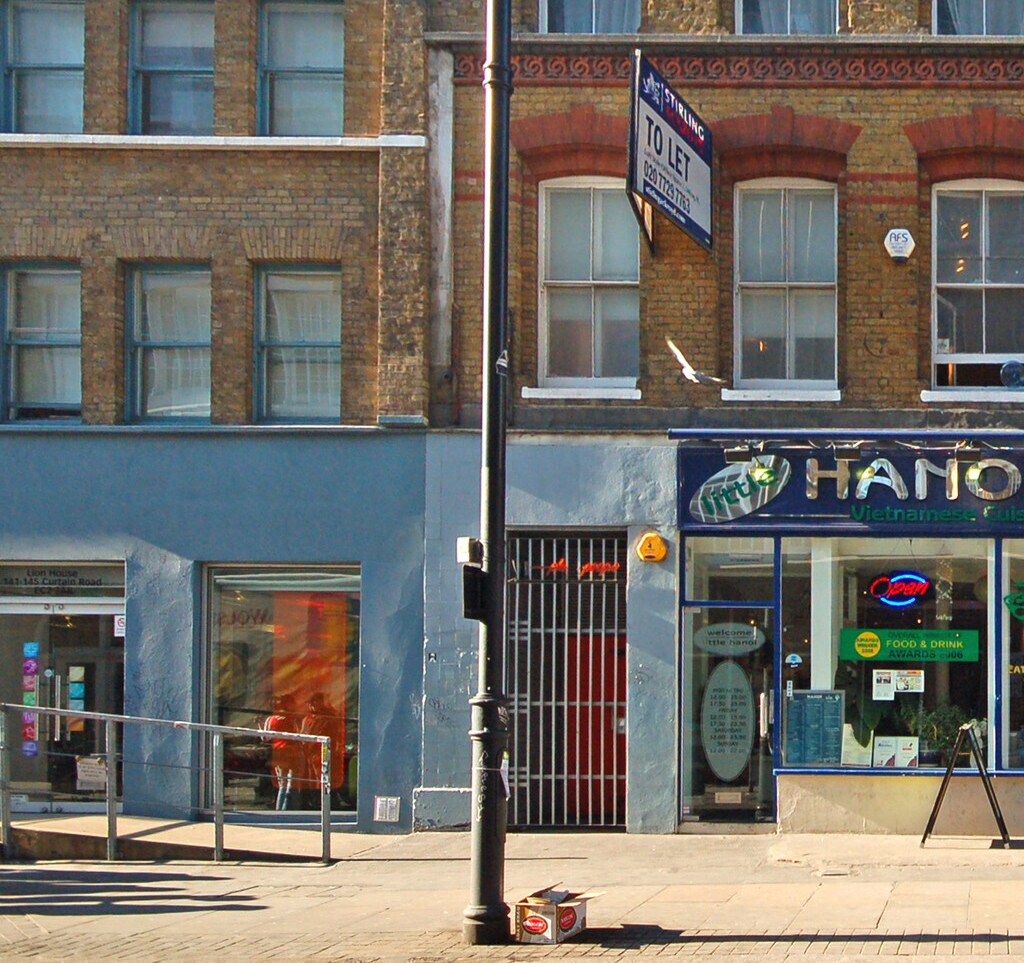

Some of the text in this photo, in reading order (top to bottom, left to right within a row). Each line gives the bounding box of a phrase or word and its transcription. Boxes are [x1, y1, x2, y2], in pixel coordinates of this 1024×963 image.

[664, 88, 705, 141] STIRLING
[646, 115, 663, 156] TO
[668, 137, 691, 182] LET
[644, 160, 658, 185] 020
[890, 232, 909, 243] AFS
[702, 469, 779, 516] little
[851, 505, 977, 523] Vietnamese
[27, 569, 78, 577] Lion House
[42, 577, 76, 586] Curtain
[79, 577, 103, 586] Road
[870, 576, 930, 598] Open
[707, 628, 753, 636] welcome
[886, 639, 964, 649] FOOD & DRINK
[889, 649, 936, 659] AWARDS
